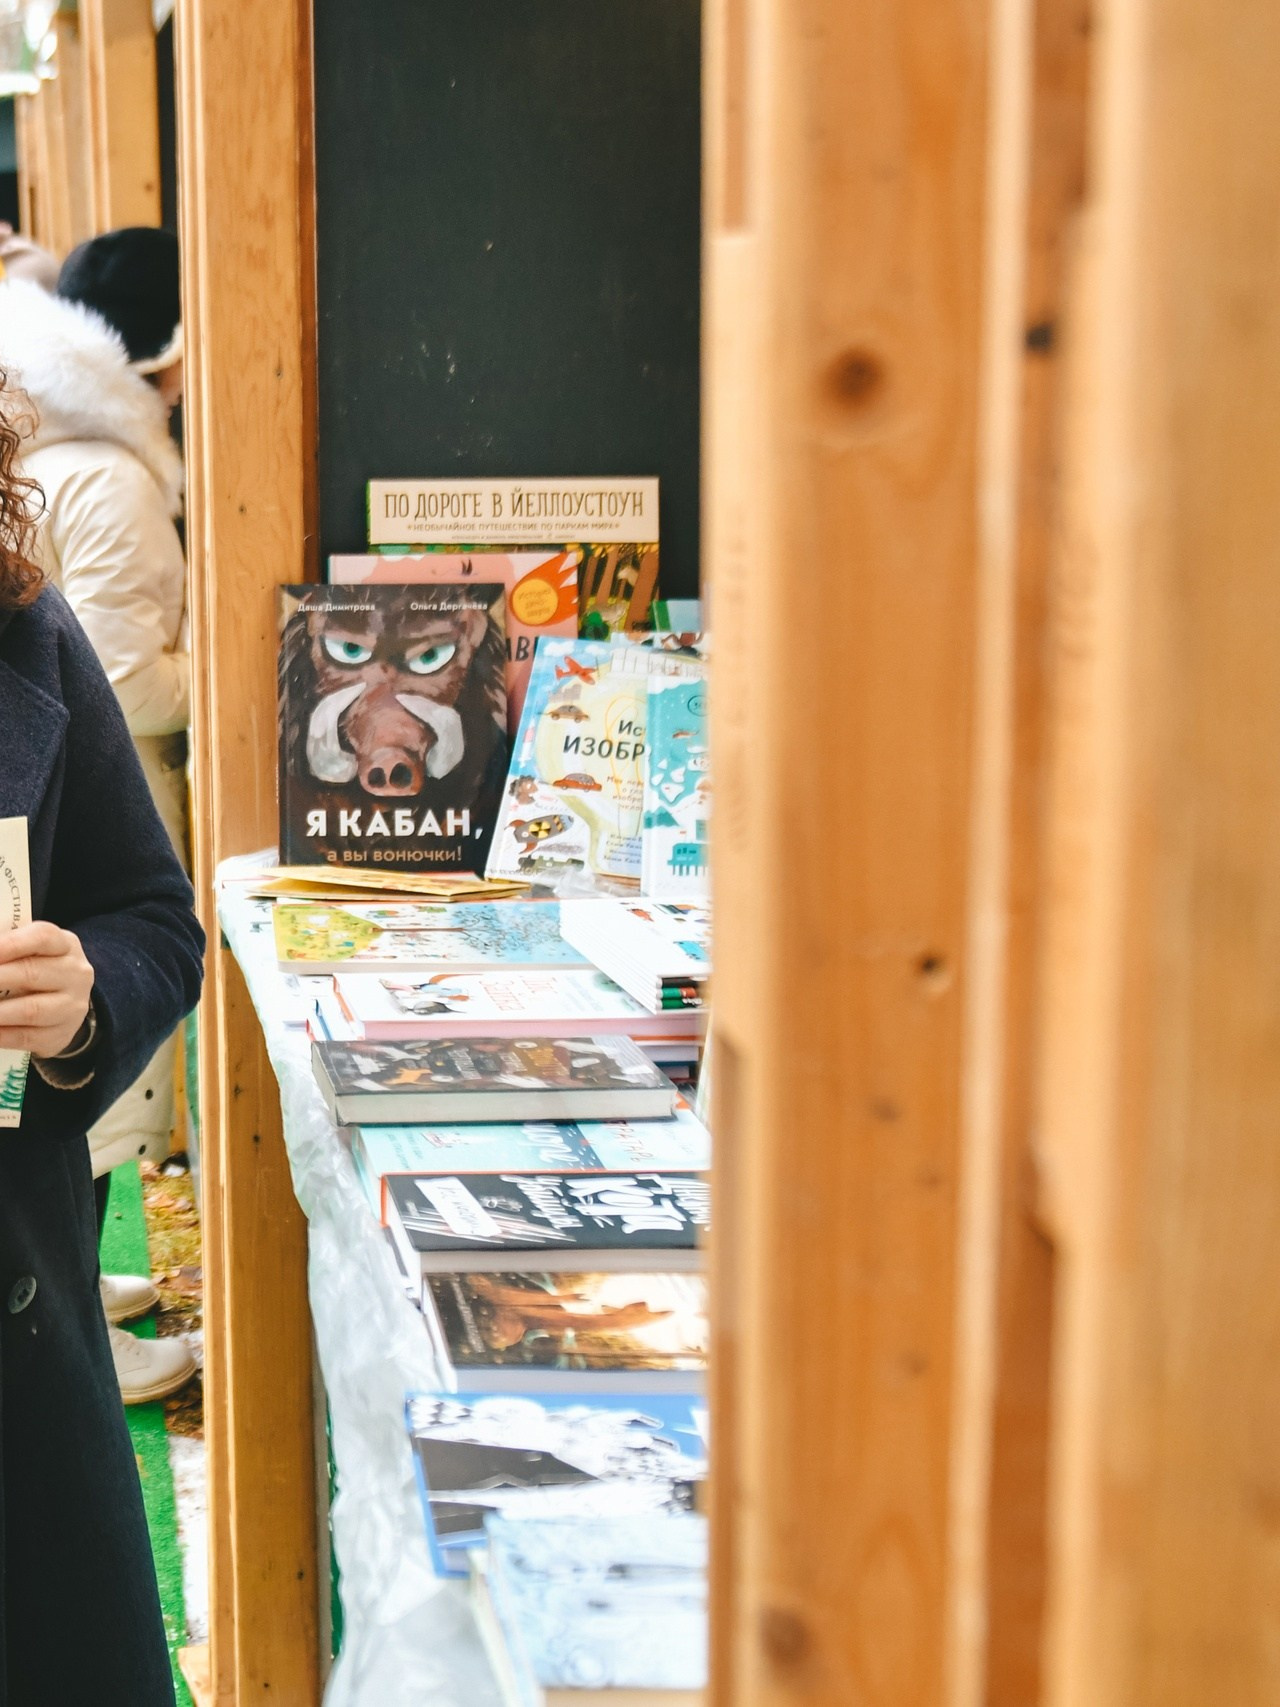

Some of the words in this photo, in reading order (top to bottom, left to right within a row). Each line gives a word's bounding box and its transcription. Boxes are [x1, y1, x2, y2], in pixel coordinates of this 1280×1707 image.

[385, 491, 409, 518] ПО
[414, 491, 482, 521] ДОРОГЕ
[492, 492, 502, 518] В
[511, 486, 644, 518] ЙЕЛЛОУСТОУН
[325, 603, 376, 612] Димитрова
[410, 602, 437, 612] Ольга
[618, 720, 646, 737] Ис
[306, 809, 327, 837] Я
[339, 809, 483, 840] КАБАН,
[327, 851, 337, 862] а
[343, 851, 368, 862] вы
[373, 846, 462, 862] вонючки!
[4, 867, 21, 930] ФЕСТИВА
